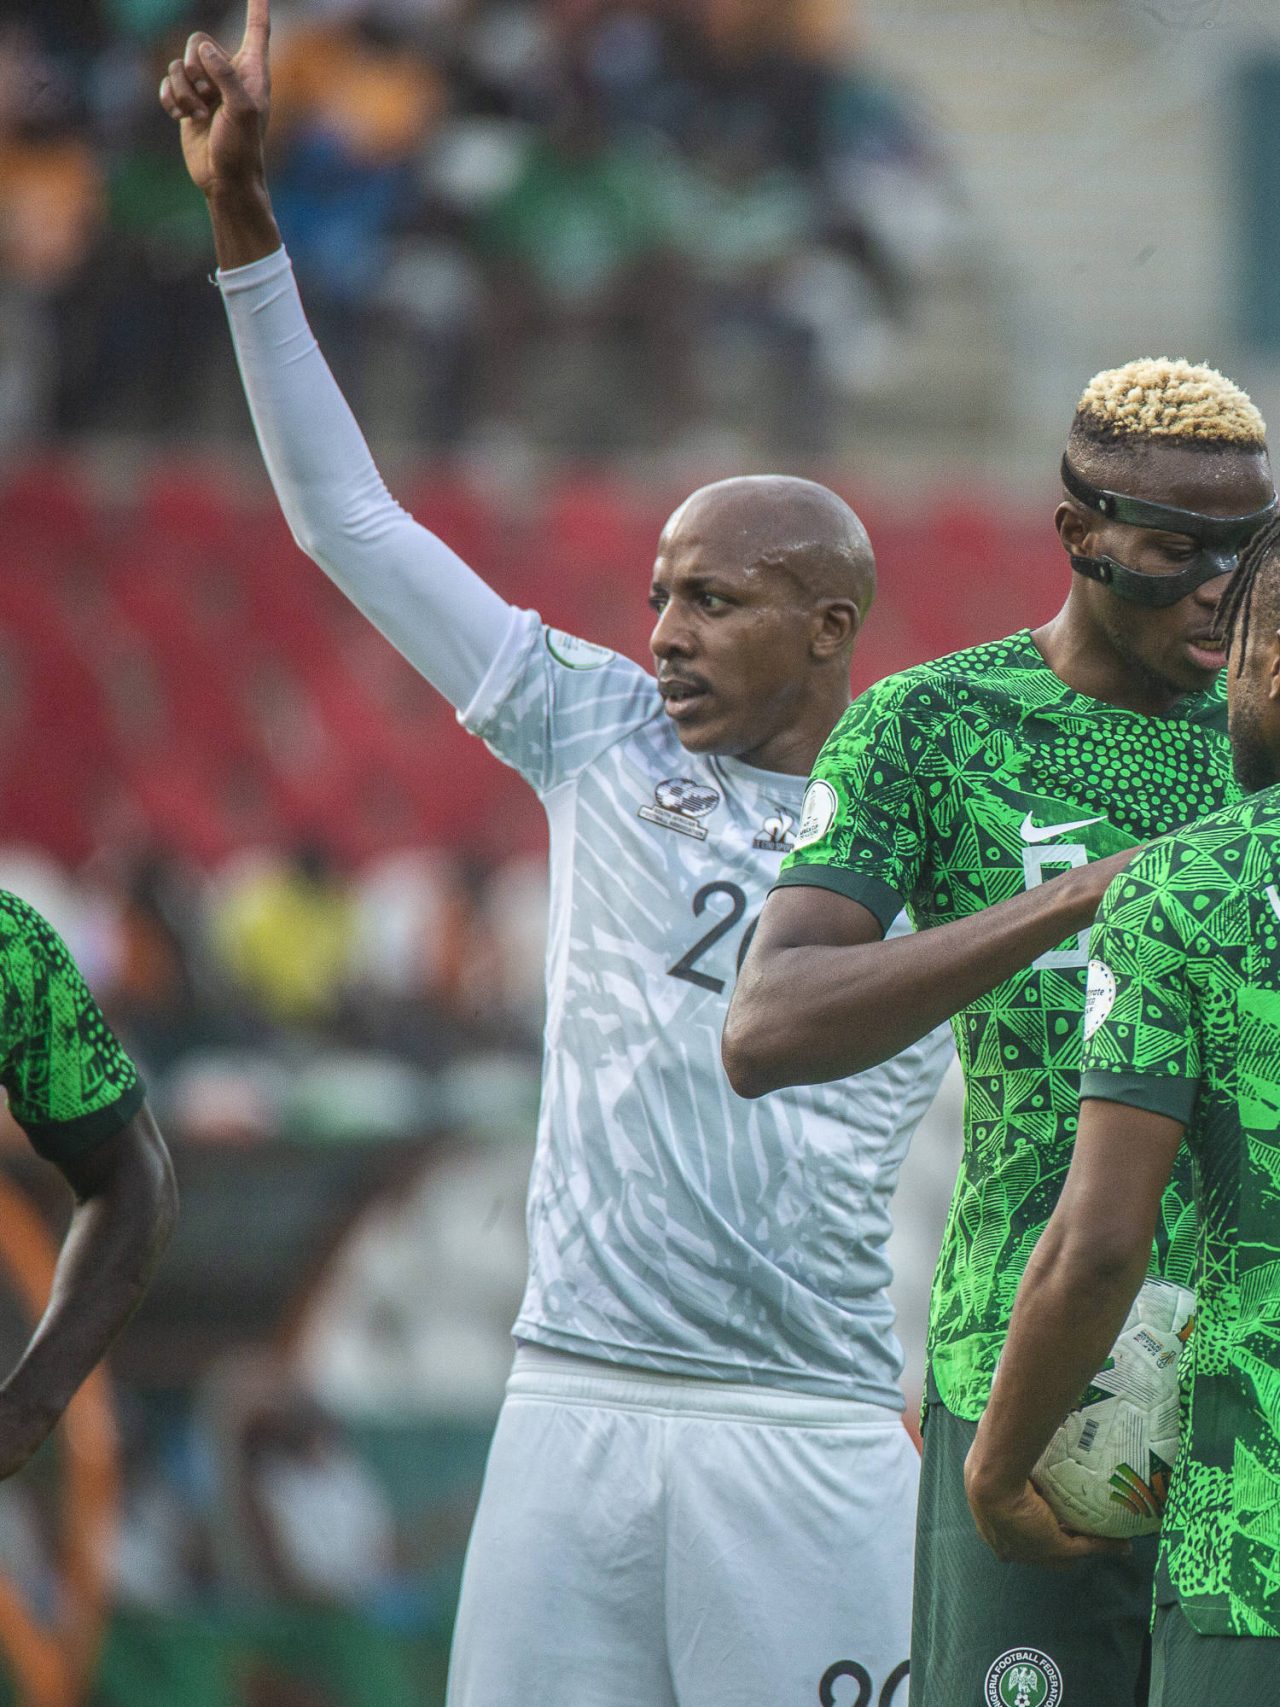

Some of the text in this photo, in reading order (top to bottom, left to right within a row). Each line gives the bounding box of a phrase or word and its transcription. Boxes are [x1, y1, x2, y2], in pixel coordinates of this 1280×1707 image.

[666, 881, 760, 995] 2
[995, 1652, 1038, 1674] FOOTBALL
[1040, 1659, 1058, 1707] FEDERATIO
